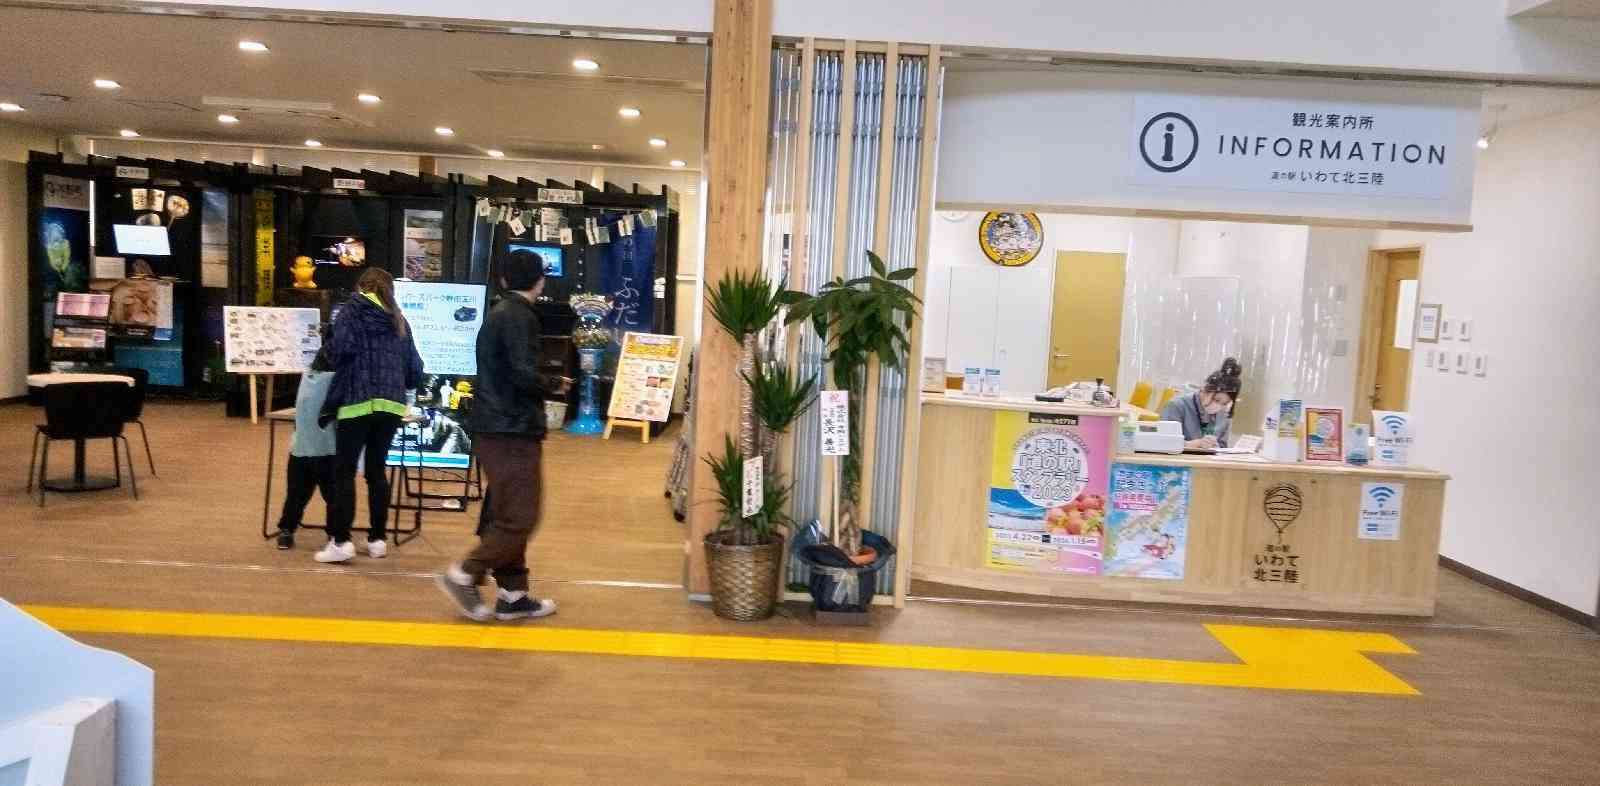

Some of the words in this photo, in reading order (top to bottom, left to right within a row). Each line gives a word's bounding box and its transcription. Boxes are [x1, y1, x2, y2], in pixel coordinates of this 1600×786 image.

[1291, 112, 1375, 130] 観光案内所
[1218, 134, 1447, 165] INFORMATION
[1300, 171, 1385, 186] いわて北三陸
[1036, 437, 1068, 456] 東北
[1011, 469, 1090, 484] スタンプラリー
[1033, 482, 1073, 501] 2023
[1255, 554, 1299, 567] いわて
[1253, 568, 1300, 583] 北三陸
